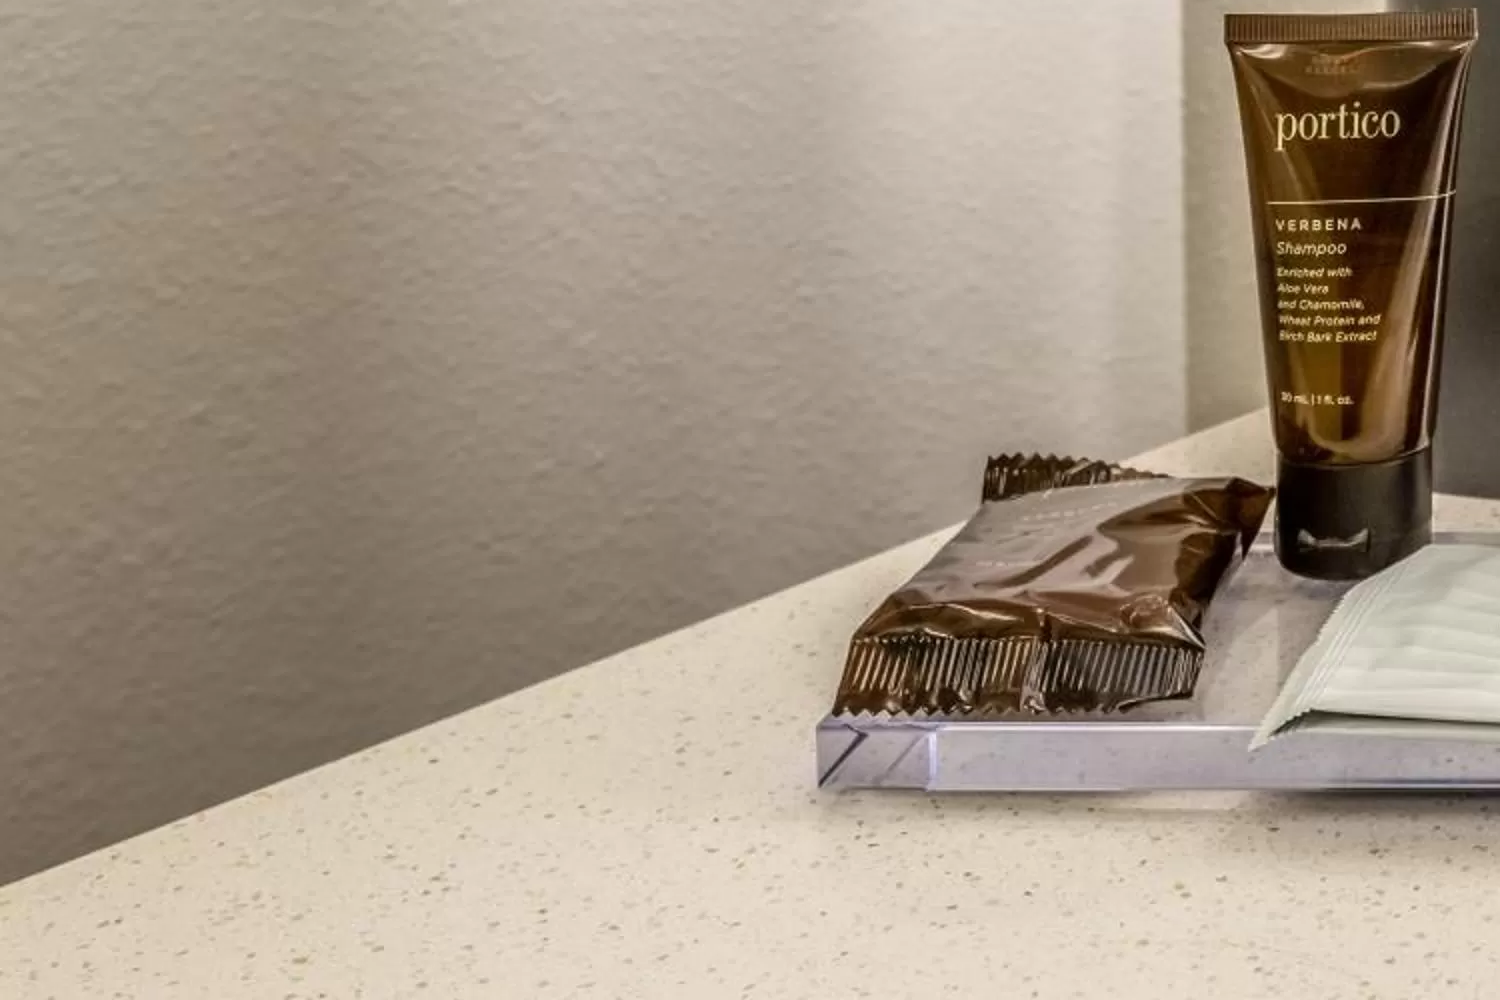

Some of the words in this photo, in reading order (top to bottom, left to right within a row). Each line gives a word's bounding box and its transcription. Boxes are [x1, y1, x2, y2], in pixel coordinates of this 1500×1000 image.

[1274, 101, 1400, 152] portico
[1275, 217, 1362, 232] VERBENA
[1276, 241, 1347, 257] Shampoo
[1276, 266, 1325, 278] Enriched
[1327, 266, 1352, 278] with
[1276, 283, 1300, 294] Aloe
[1303, 283, 1329, 294] Vera
[1314, 315, 1355, 326] Protein
[1358, 313, 1382, 325] and
[1279, 330, 1304, 342] Birch
[1307, 331, 1333, 343] Bark
[1335, 330, 1378, 343] Extract
